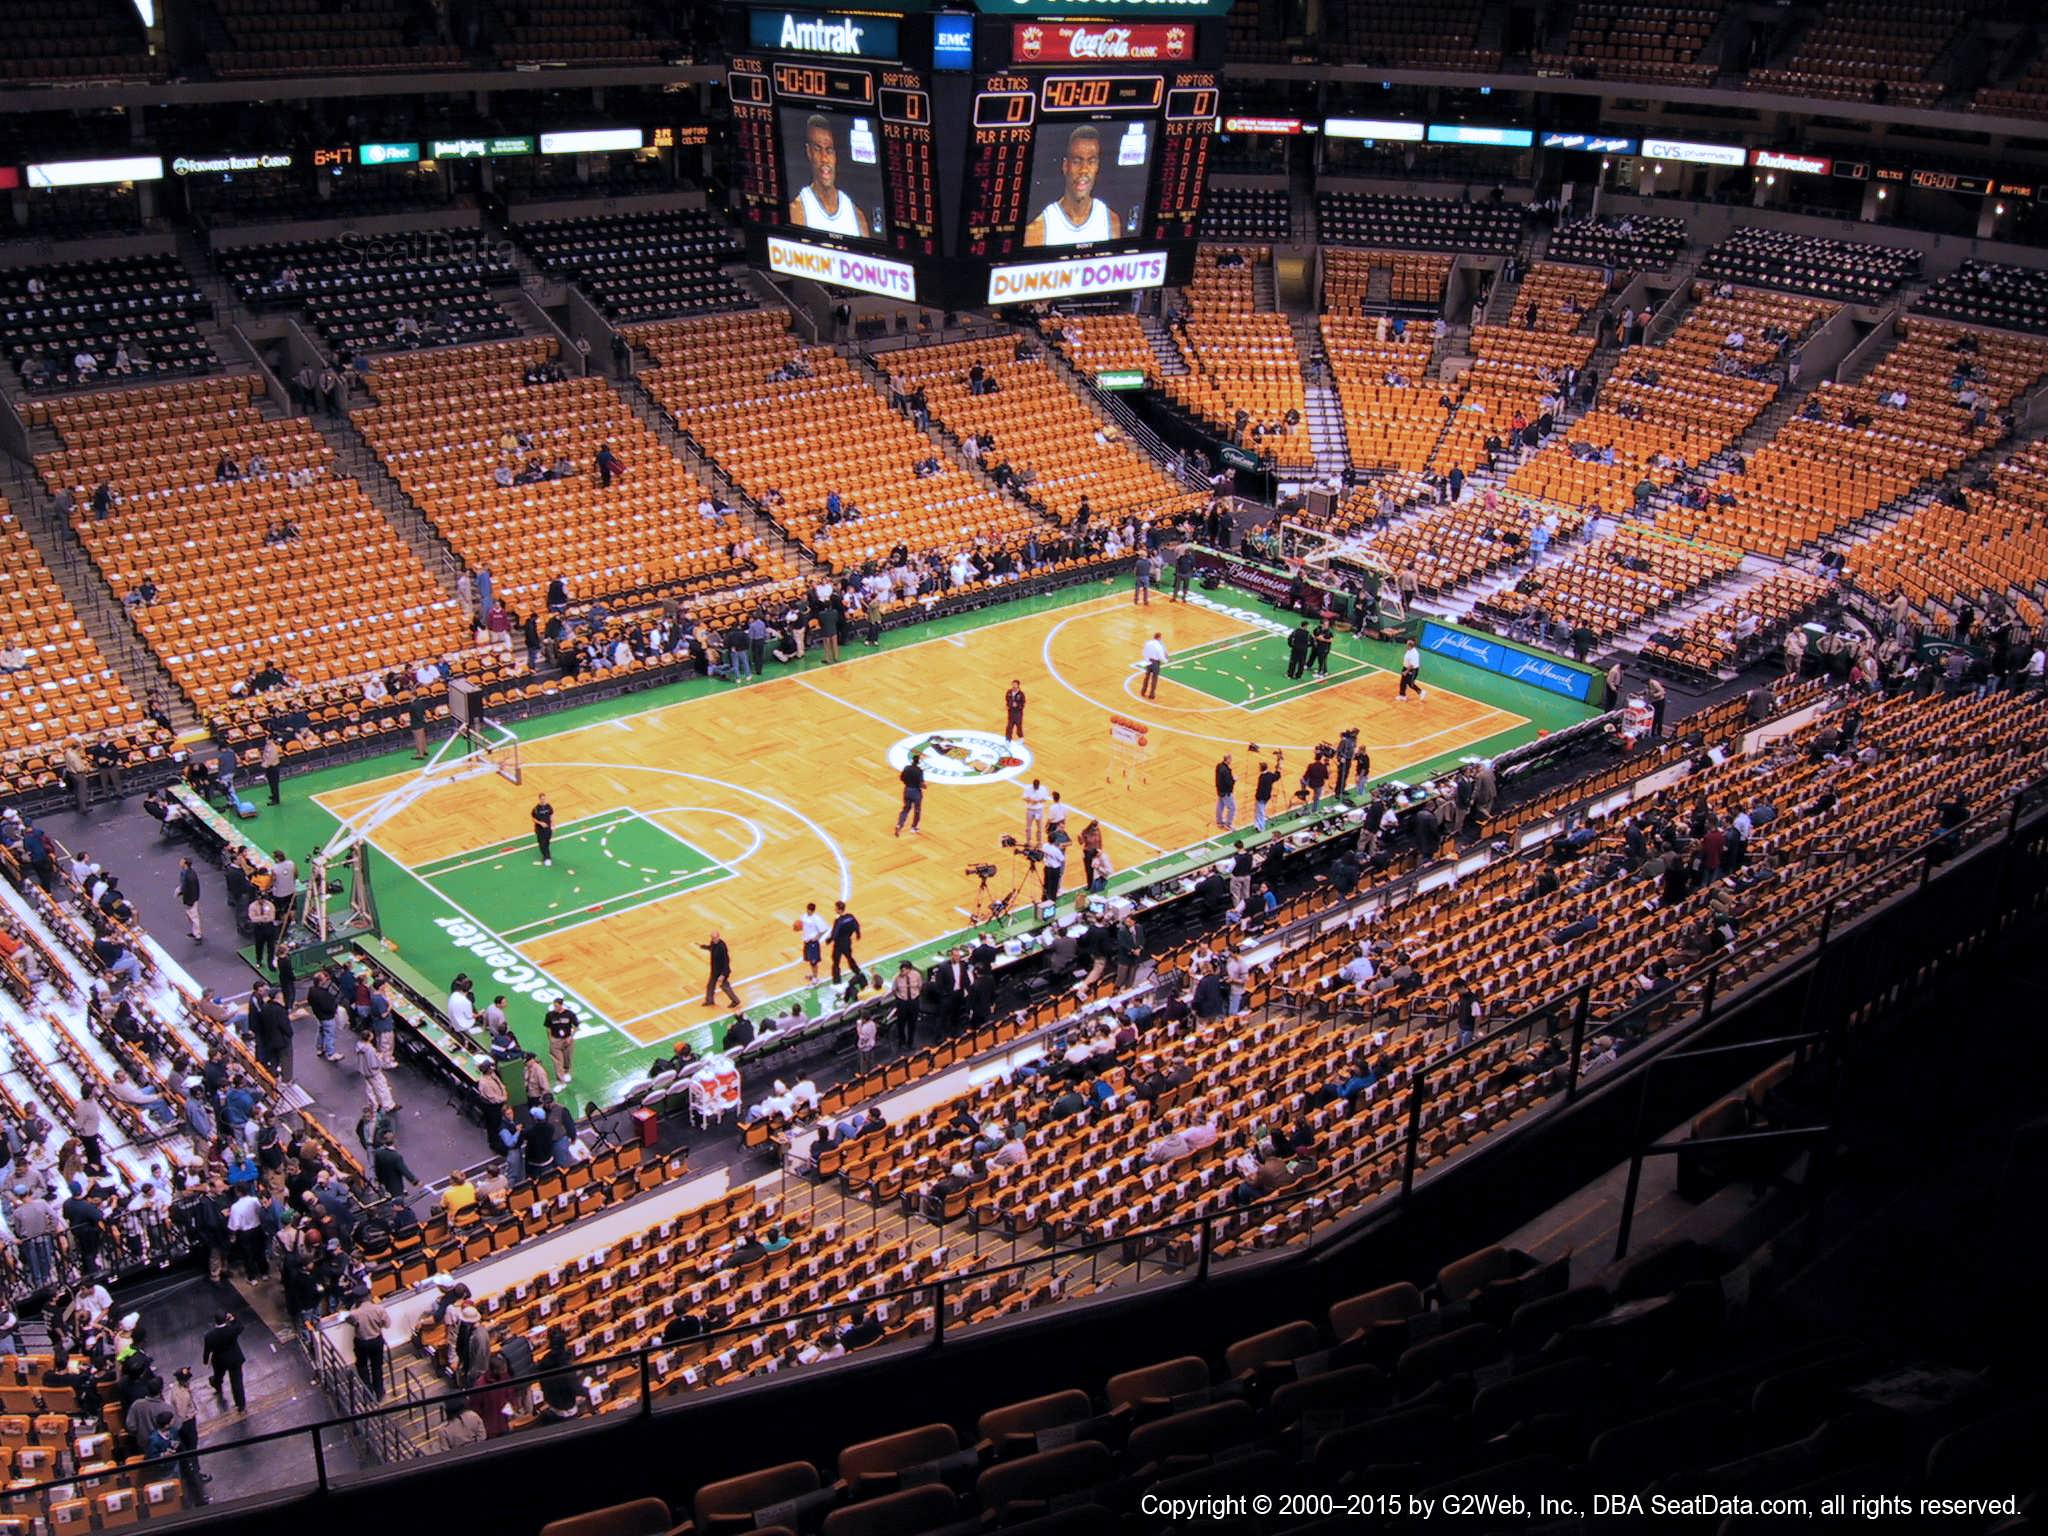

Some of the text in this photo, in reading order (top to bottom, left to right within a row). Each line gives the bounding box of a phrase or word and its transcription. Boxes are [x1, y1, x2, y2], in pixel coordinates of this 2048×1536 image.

[733, 58, 763, 73] CELTICS
[776, 69, 827, 96] 40:00
[883, 72, 920, 88] RAPTORS
[987, 76, 1029, 92] CELTICS
[1176, 73, 1215, 87] RAPTORS
[752, 78, 762, 101] 0
[1047, 81, 1110, 106] 40:00
[906, 95, 919, 119] 0
[1007, 97, 1024, 121] 0
[1193, 92, 1209, 115] 0
[733, 106, 748, 118] PLR
[757, 109, 772, 121] PTS
[884, 125, 900, 138] PLR
[912, 128, 930, 142] PTS
[976, 130, 996, 144] PLR
[1010, 129, 1032, 143] PTS
[1166, 123, 1183, 136] PLR
[1196, 122, 1214, 134] PTS
[681, 136, 706, 146] CELTICS
[314, 148, 352, 166] 6:47
[1652, 144, 1681, 157] CVS
[1756, 151, 1825, 173] Budweiser
[1913, 172, 1957, 189] 40:00
[771, 246, 910, 292] DUNKIN' DONUTS
[994, 259, 1161, 295] DUNKIN' DONUTS
[1226, 561, 1291, 592] Budweiser
